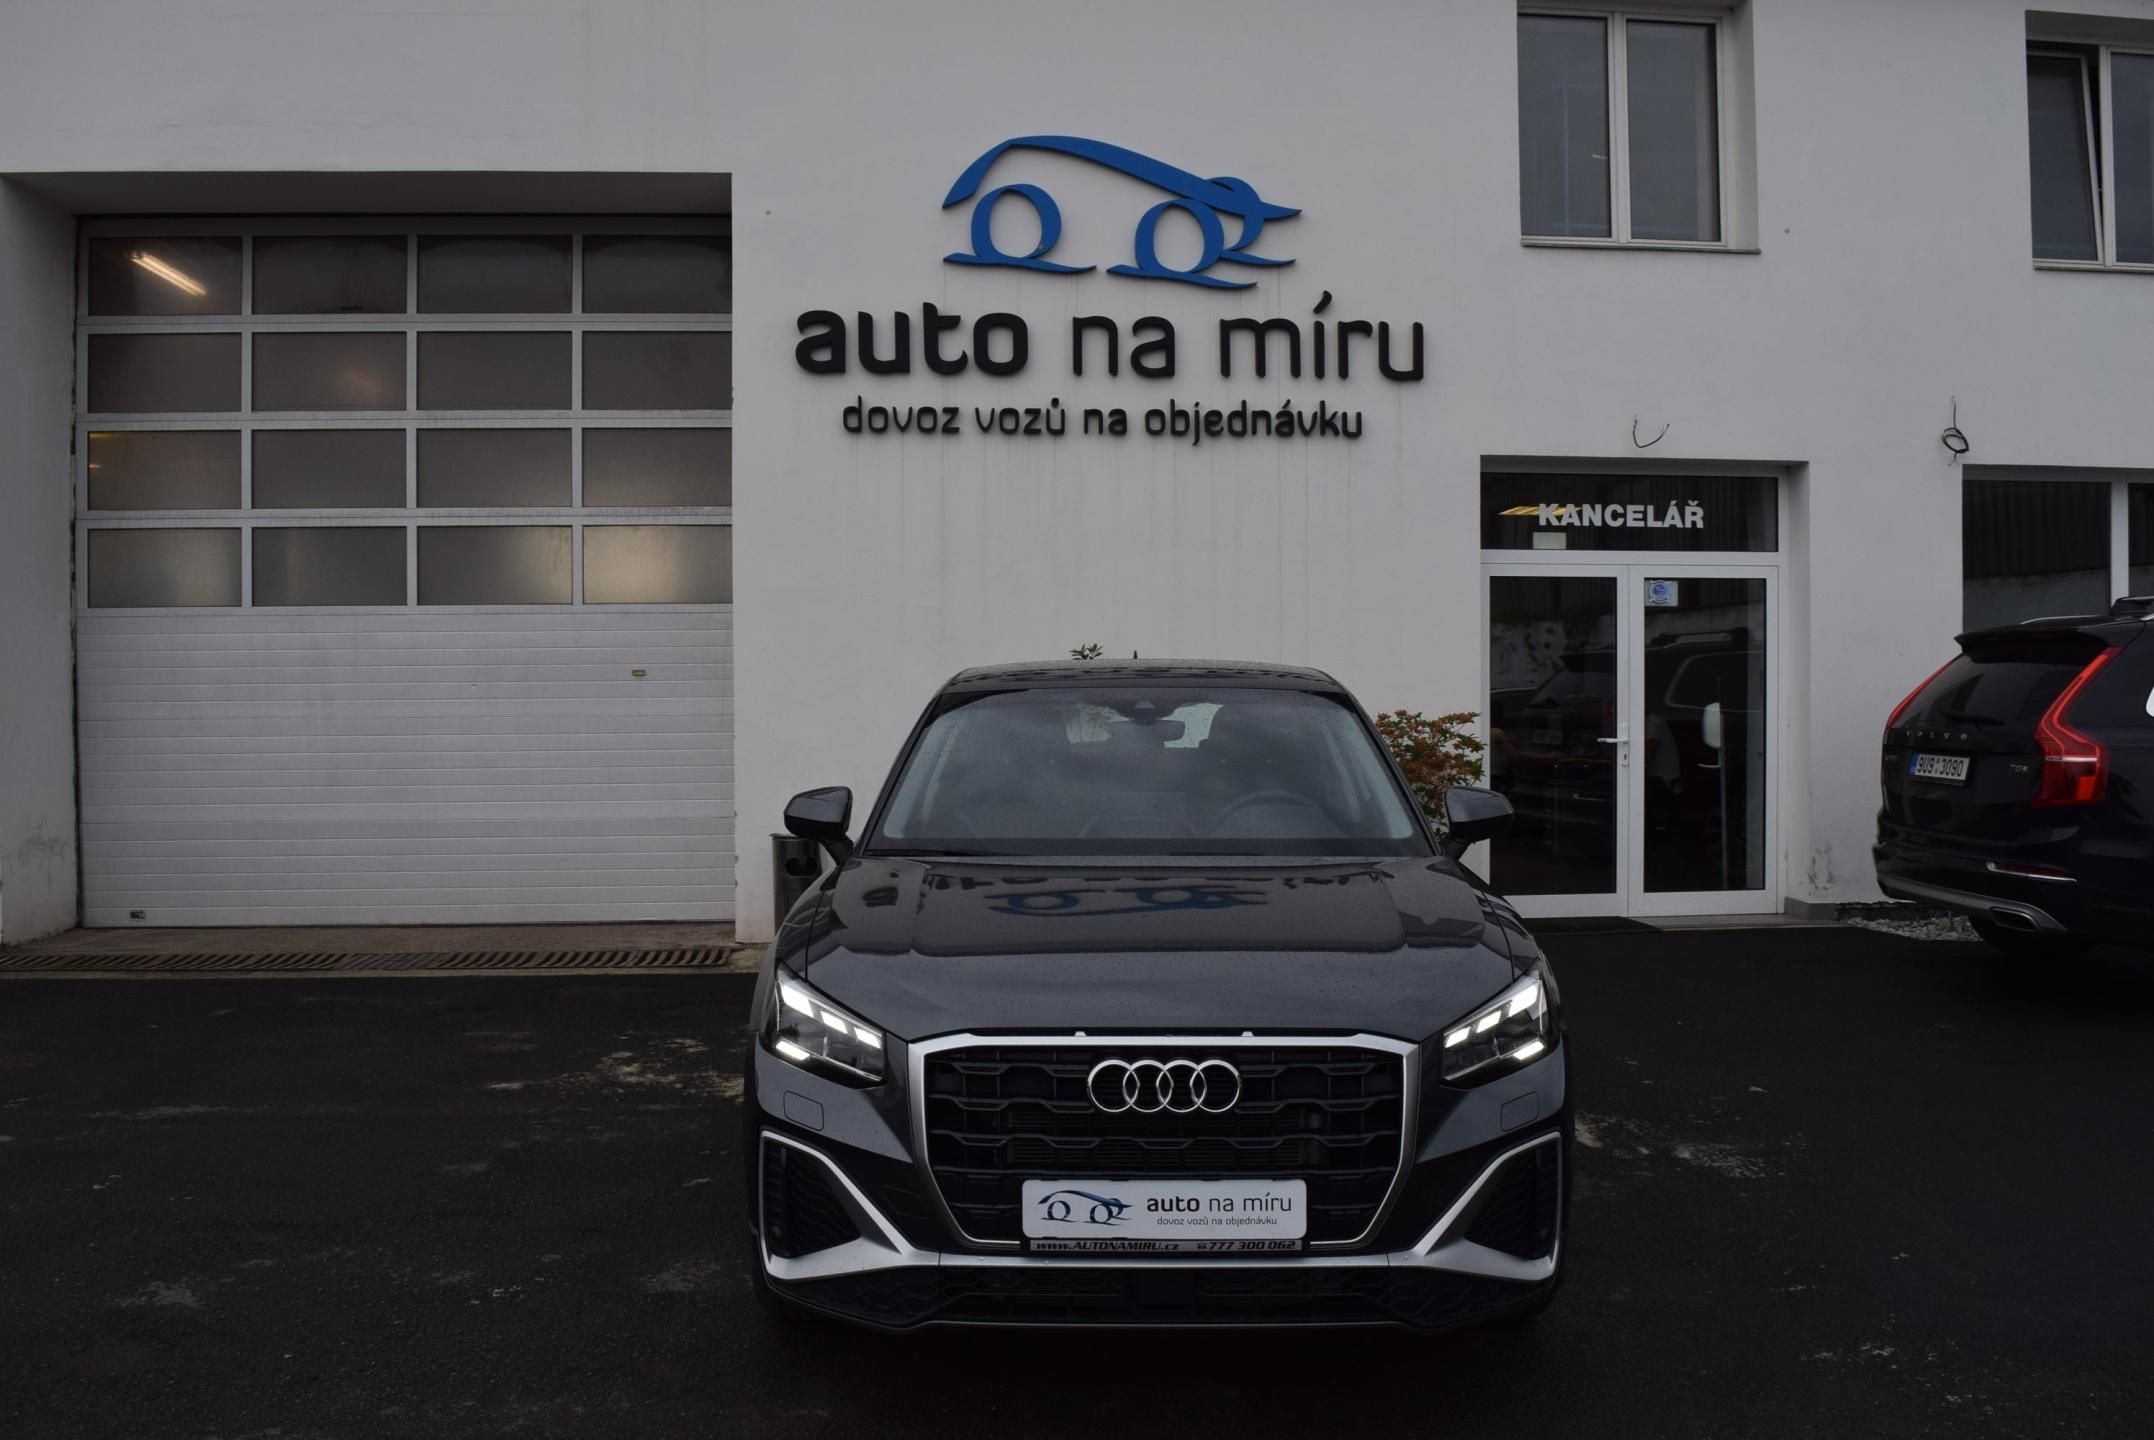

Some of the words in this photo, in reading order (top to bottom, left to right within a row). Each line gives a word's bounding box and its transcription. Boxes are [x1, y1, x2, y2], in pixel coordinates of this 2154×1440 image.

[794, 302, 1030, 377] auto
[1072, 315, 1176, 379] na
[1218, 290, 1425, 382] míru
[842, 396, 961, 436] dovoz
[974, 398, 1067, 437] vozů
[1083, 408, 1129, 436] na
[1144, 399, 1363, 446] objednávku
[1538, 501, 1705, 529] KANCELÁŘ
[1917, 756, 1935, 774] 9U9
[1939, 758, 1964, 777] 3090
[1146, 1195, 1200, 1212] auto
[1209, 1197, 1234, 1212] na
[1243, 1192, 1292, 1212] míru
[1157, 1216, 1185, 1226] dovoz
[1187, 1216, 1209, 1226] vozů
[1211, 1217, 1223, 1226] na
[1226, 1216, 1278, 1228] objednávku
[1036, 1241, 1180, 1251] www.AUTONAMIRU.cz
[1209, 1241, 1234, 1250] 777
[1237, 1241, 1265, 1250] 300
[1267, 1241, 1296, 1250] 062
